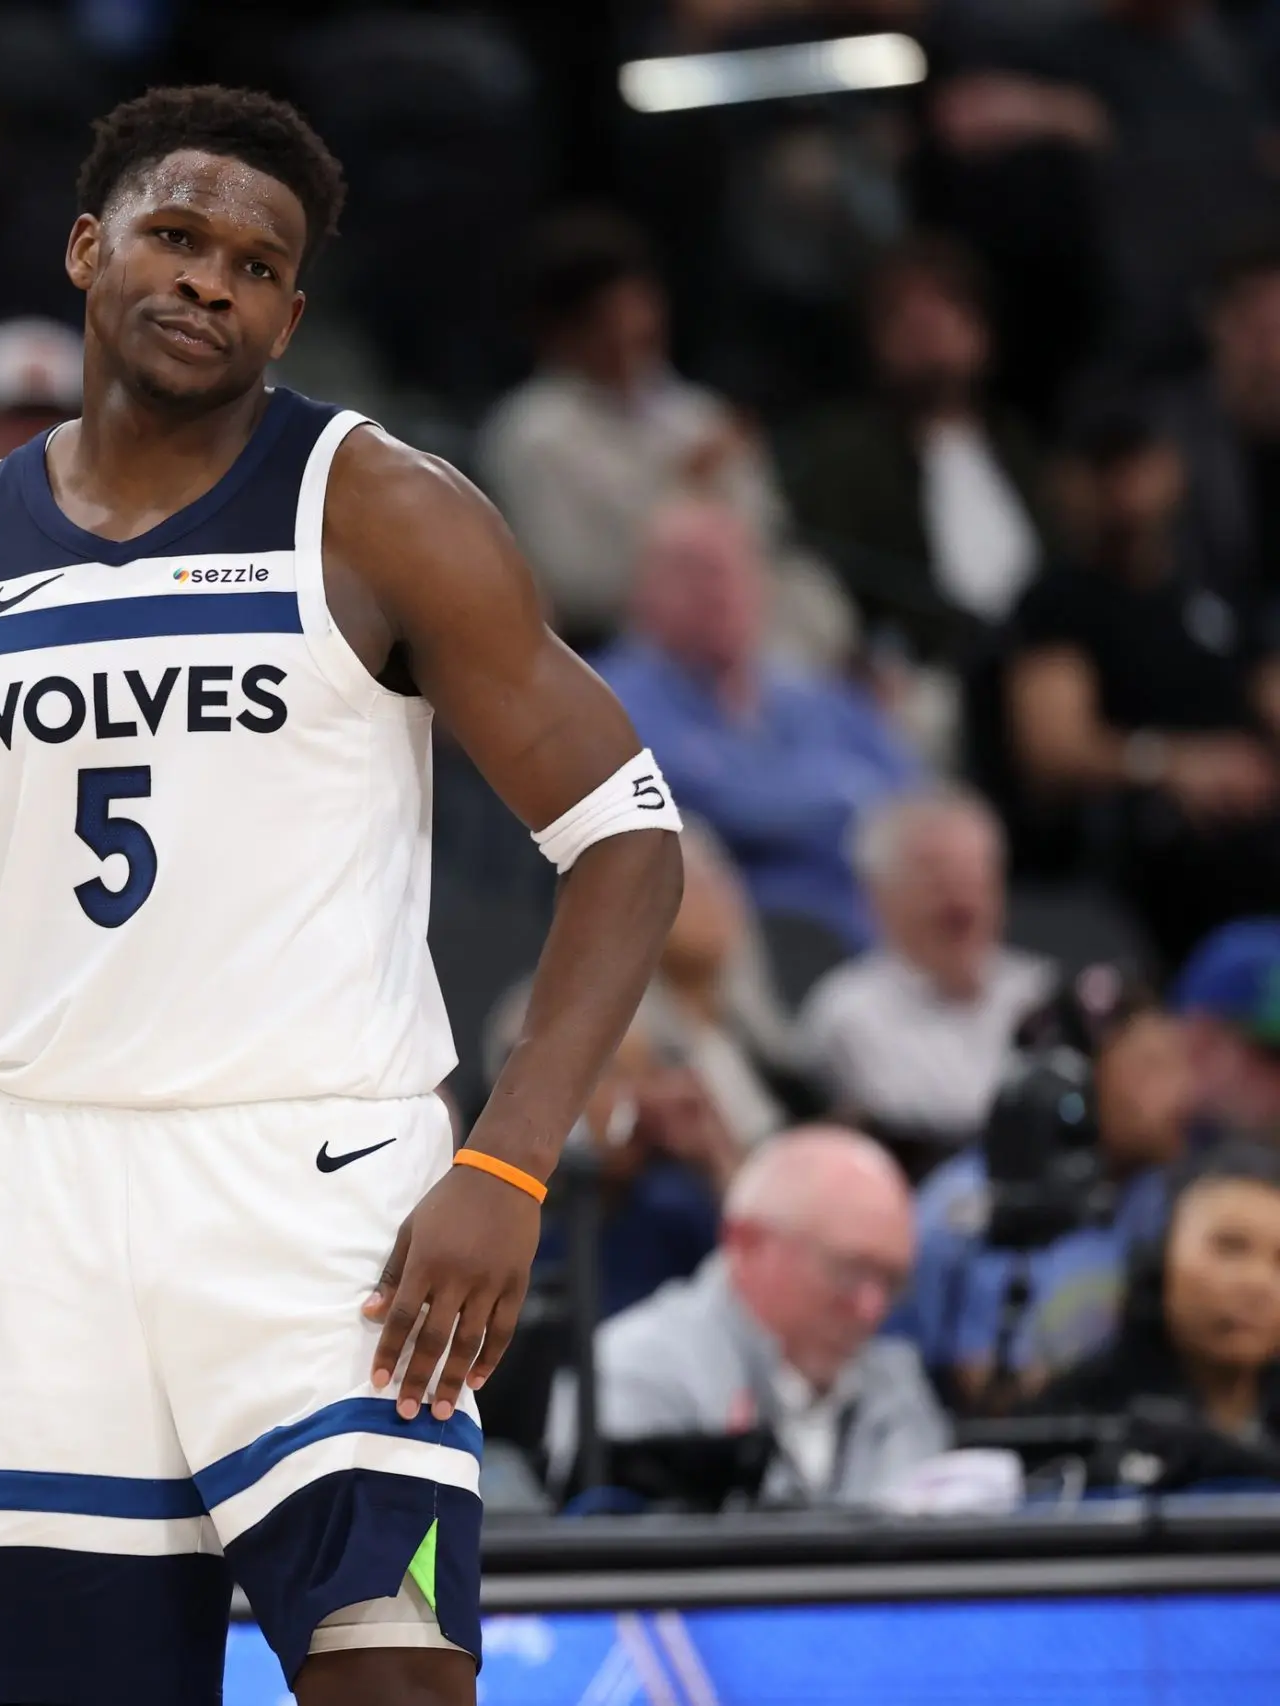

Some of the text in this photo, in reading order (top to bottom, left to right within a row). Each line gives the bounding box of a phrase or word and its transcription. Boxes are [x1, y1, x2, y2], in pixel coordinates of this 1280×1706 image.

[191, 563, 269, 583] sezzle
[632, 775, 665, 810] 5
[73, 765, 158, 929] 5
